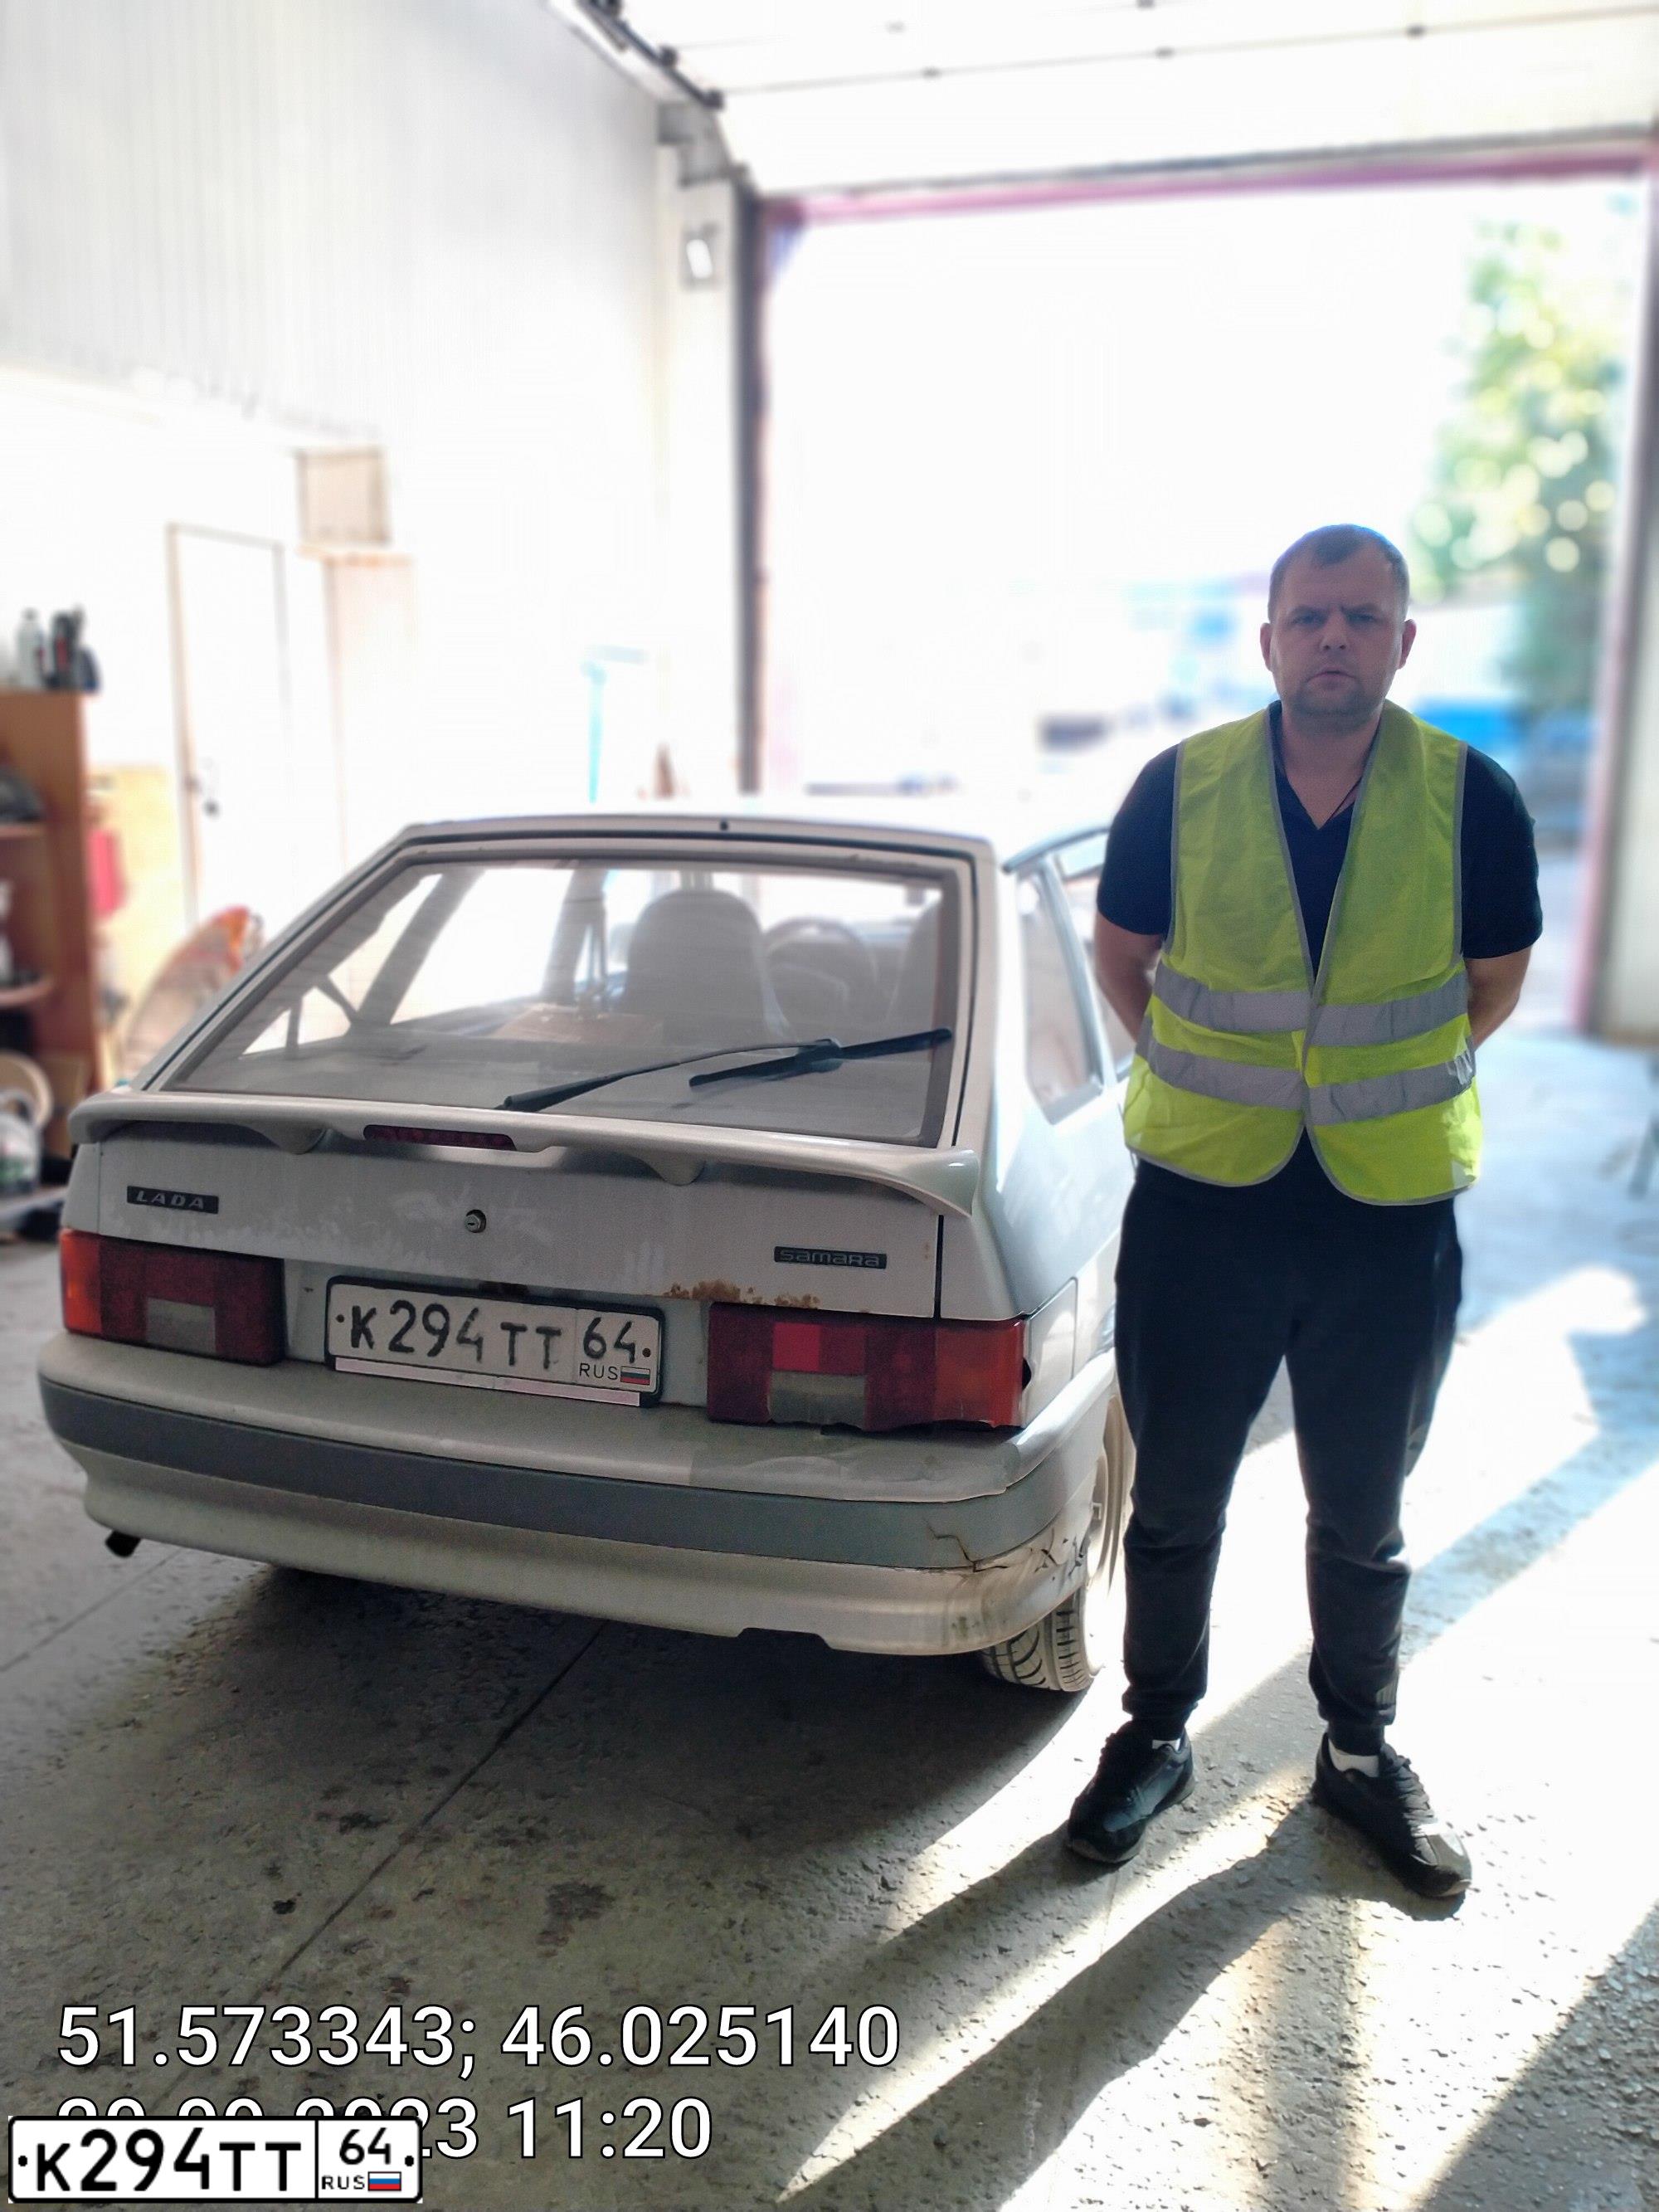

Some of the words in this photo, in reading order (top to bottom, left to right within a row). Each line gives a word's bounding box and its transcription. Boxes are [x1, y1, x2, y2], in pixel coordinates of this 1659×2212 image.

[136, 1190, 204, 1210] LADA
[583, 1317, 636, 1363] 64
[579, 1362, 618, 1381] RUS
